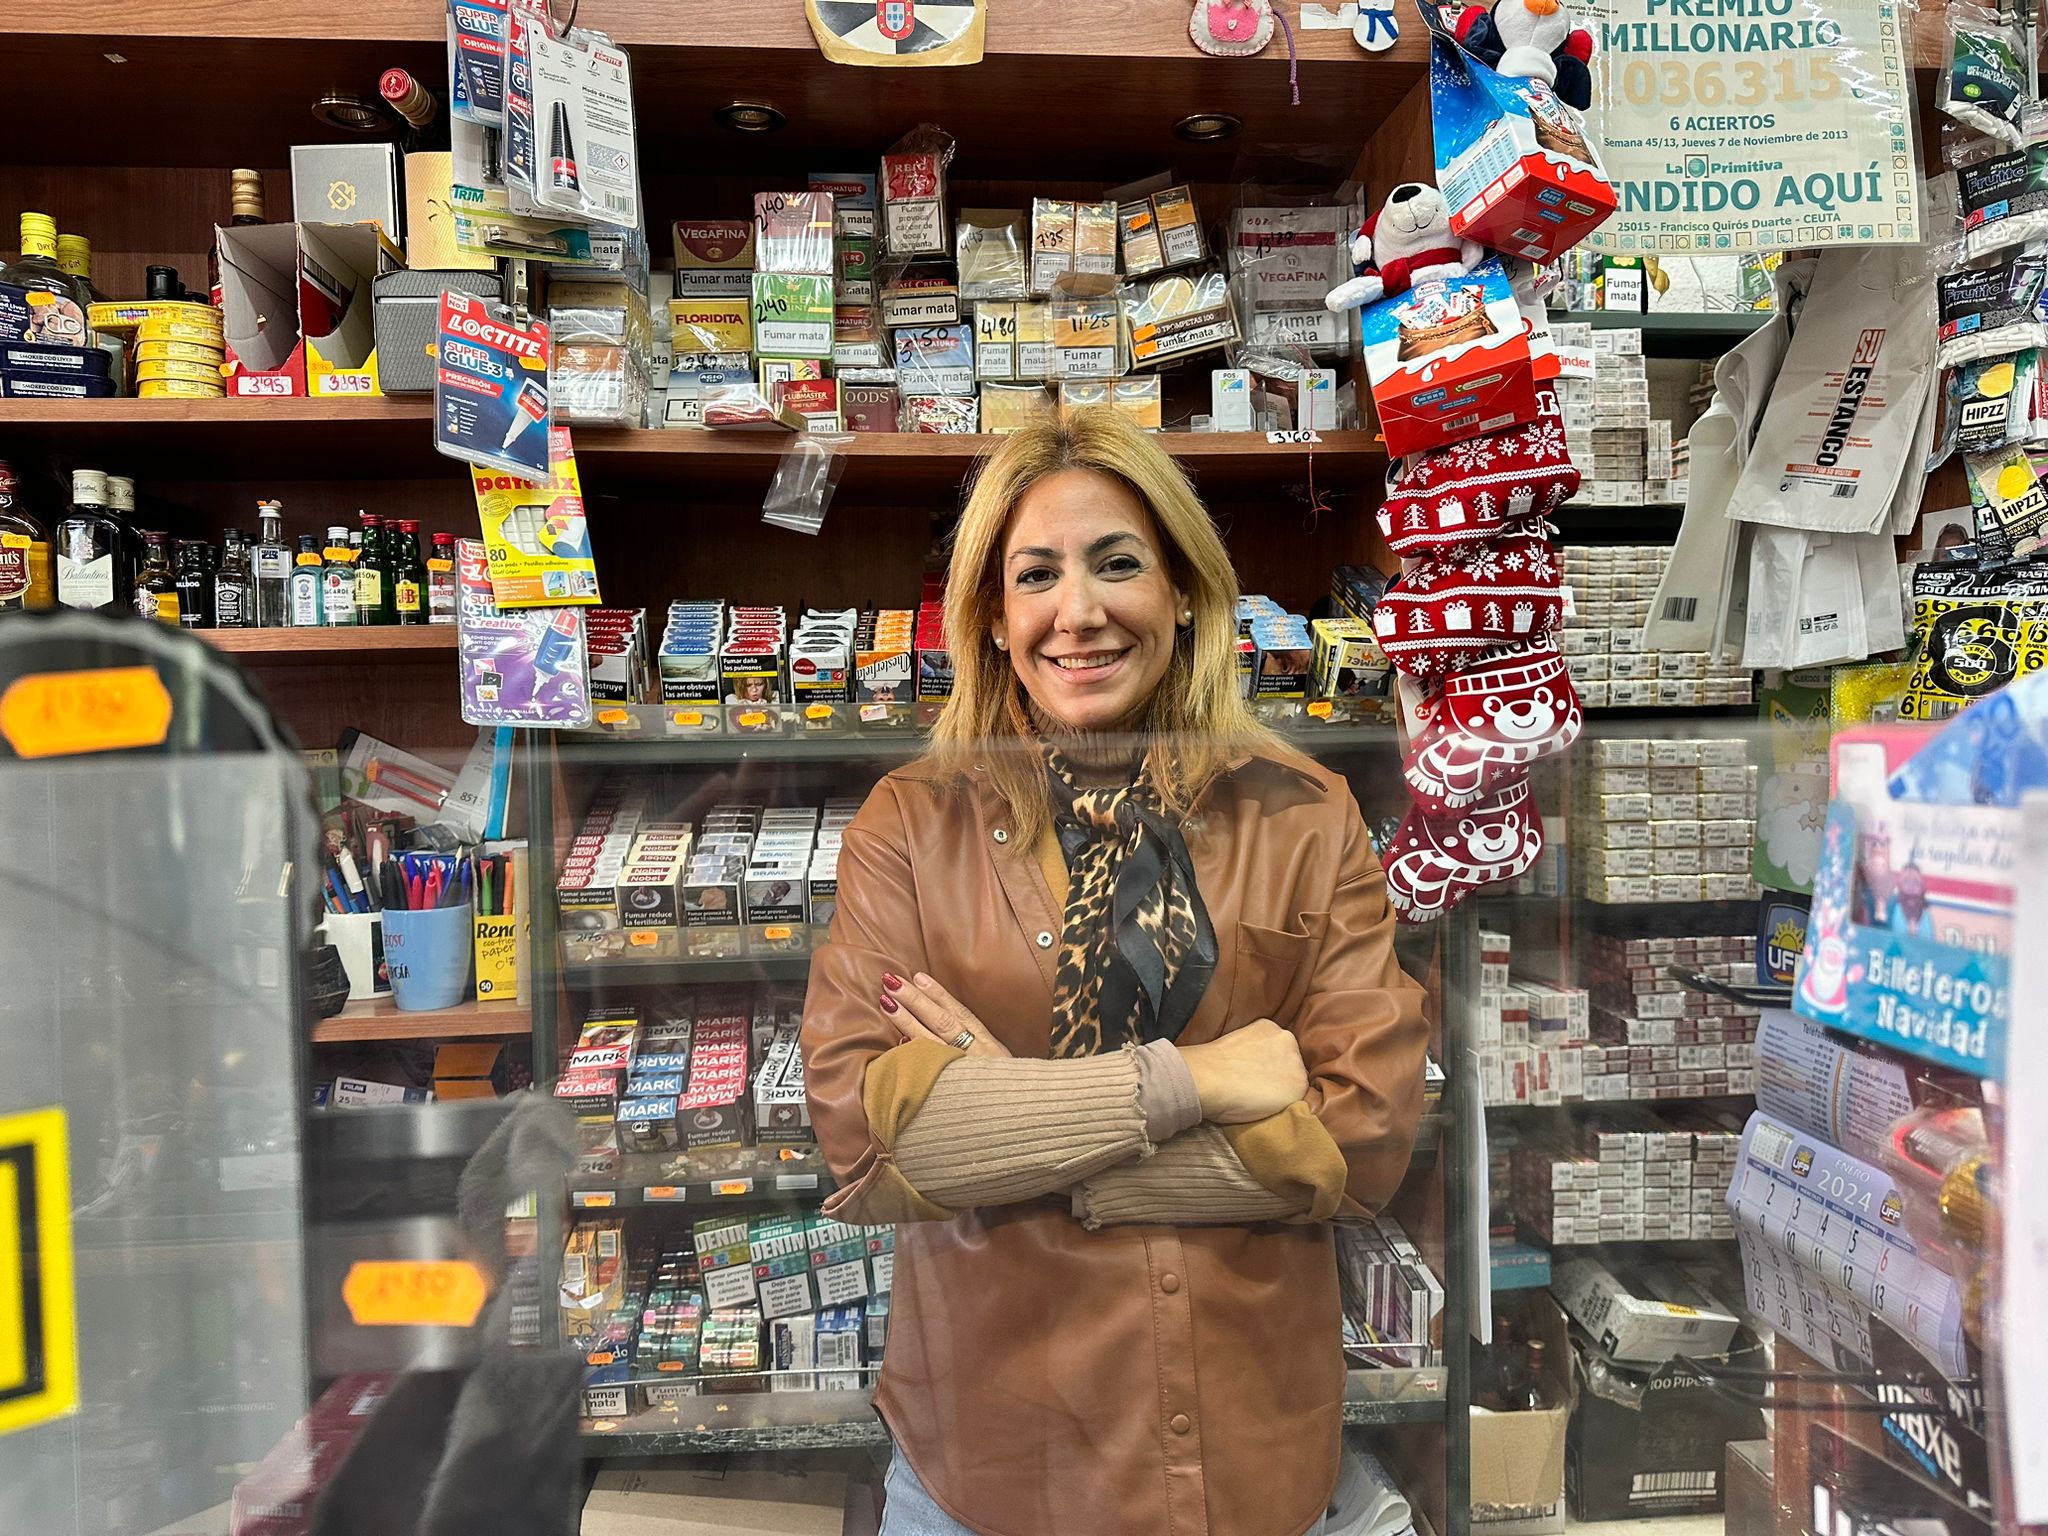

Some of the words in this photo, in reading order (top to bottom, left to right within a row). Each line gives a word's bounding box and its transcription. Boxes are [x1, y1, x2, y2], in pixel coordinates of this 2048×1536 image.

[456, 6, 497, 23] SUPER
[1602, 21, 1842, 53] MILLONARIO
[1669, 117, 1680, 131] 6
[1685, 114, 1775, 130] ACIERTOS
[1604, 137, 1642, 147] Semana
[1646, 137, 1679, 149] 45/13,
[1682, 136, 1716, 148] Jueves
[1719, 138, 1725, 146] 7
[1728, 136, 1741, 146] de
[1744, 132, 1803, 146] Noviembre
[1806, 131, 1819, 141] de
[1822, 130, 1848, 140] 2013
[1666, 163, 1683, 174] La
[1711, 160, 1783, 174] Primitiva
[1990, 162, 2010, 171] APPLE
[2011, 156, 2027, 167] MINT
[822, 184, 863, 194] SIGNATURE
[848, 216, 872, 224] mata
[1618, 222, 1650, 232] 25015
[1660, 220, 1709, 232] Francisco
[1713, 219, 1748, 233] Quirós
[1752, 217, 1791, 229] Duarte
[1803, 213, 1841, 224] CEUTA
[680, 228, 747, 239] VEGAFINA
[1165, 229, 1194, 242] Fumar
[593, 245, 619, 257] mata
[1172, 239, 1194, 251] mata
[682, 274, 721, 285] Fumar
[724, 272, 751, 286] mata
[1258, 271, 1328, 283] VEGAFINA
[1606, 278, 1641, 289] Fumar
[1609, 290, 1638, 302] mata
[885, 306, 922, 316] Fumar
[926, 304, 954, 313] mata
[676, 314, 744, 326] FLORIDITA
[1162, 316, 1202, 332] TROMPETAS
[1267, 314, 1323, 327] Fumar
[447, 314, 542, 358] LOCTITE
[764, 330, 796, 341] Fumar
[799, 330, 824, 341] mata
[447, 341, 489, 360] SUPER
[981, 346, 1010, 355] Fumar
[1854, 330, 1885, 363] SU
[984, 357, 1006, 365] mata
[1064, 350, 1102, 360] Fumar
[445, 351, 503, 378] GLUE-3
[445, 372, 491, 390] PRECISIÓN
[783, 392, 828, 401] CLUBMASTER
[845, 392, 889, 403] OODS
[1816, 367, 1871, 467] ESTANCO
[1966, 403, 2004, 420] HIPZZ
[811, 424, 834, 432] mata
[1275, 432, 1310, 443] 3'60
[2002, 493, 2042, 519] HIPZZ
[489, 549, 507, 561] 80
[1918, 572, 1956, 580] RASTA
[1915, 585, 1944, 595] 500
[1347, 655, 1388, 666] CAMEL
[1954, 659, 1987, 668] 500
[1954, 671, 1984, 683] RASTA
[482, 944, 514, 959] paper
[480, 982, 491, 991] 50
[697, 1017, 742, 1026] MARK
[1876, 994, 1988, 1058] Navidad
[695, 1028, 741, 1039] MARK
[572, 1052, 627, 1065] MARK
[692, 1054, 741, 1066] MARK
[690, 1068, 741, 1079] MARK
[342, 1083, 366, 1092] MILAN
[557, 1082, 609, 1094] MARK
[628, 1077, 676, 1092] MARK
[338, 1095, 351, 1104] 25
[620, 1103, 670, 1119] MARK
[687, 1132, 709, 1140] Fumar
[712, 1129, 735, 1137] reduce
[698, 1136, 730, 1145] fertilidad
[1793, 1158, 1809, 1172] UFP
[1835, 1159, 1870, 1182] ENERO
[1766, 1182, 1775, 1206] 2
[1817, 1169, 1872, 1213] 2024
[1792, 1198, 1801, 1221] 3
[1881, 1205, 1900, 1220] UFP
[1759, 1214, 1765, 1235] 9
[1820, 1214, 1830, 1237] 4
[696, 1225, 748, 1252] DENIM
[760, 1227, 793, 1239] DENIM
[808, 1224, 861, 1249] DENIM
[751, 1233, 807, 1263] DENIM
[1787, 1232, 1796, 1255] 10
[1849, 1230, 1859, 1253] 5
[1814, 1248, 1823, 1272] 11
[1881, 1247, 1889, 1272] 6
[1752, 1258, 1762, 1282] 22
[1843, 1264, 1853, 1292] 12
[1776, 1274, 1787, 1299] 23
[1755, 1287, 1765, 1312] 29
[1801, 1291, 1814, 1318] 24
[1875, 1284, 1885, 1311] 13
[1779, 1304, 1791, 1331] 30
[1828, 1311, 1842, 1337] 25
[1908, 1303, 1918, 1333] 14
[1806, 1323, 1816, 1349] 31
[1857, 1329, 1871, 1359] 26
